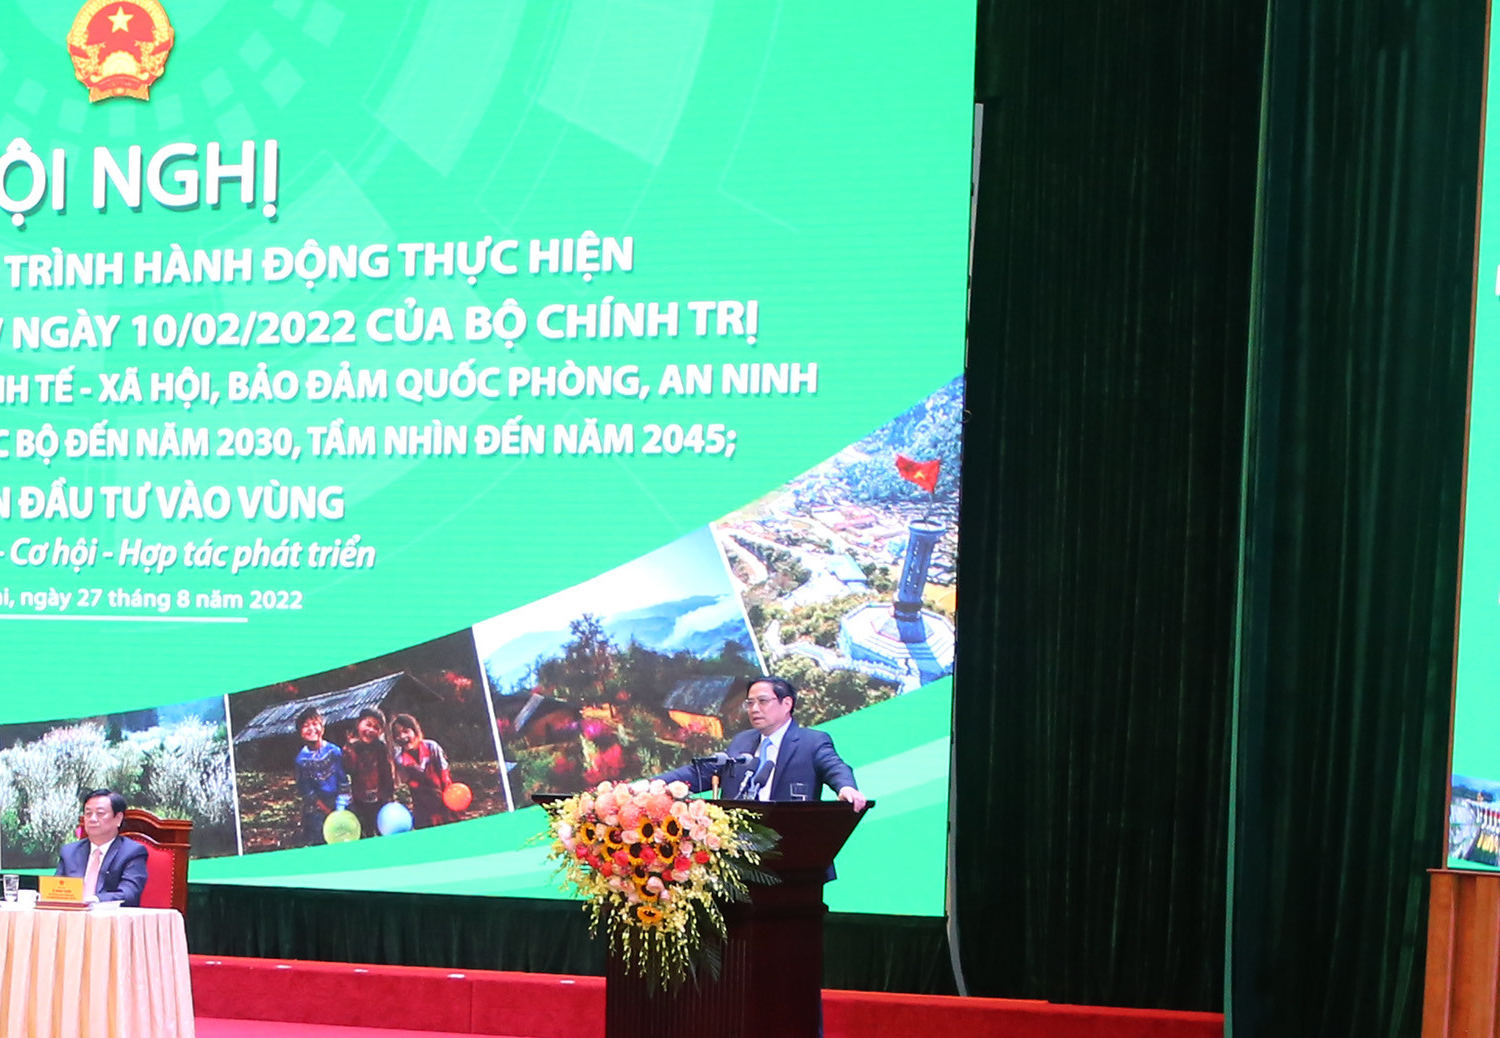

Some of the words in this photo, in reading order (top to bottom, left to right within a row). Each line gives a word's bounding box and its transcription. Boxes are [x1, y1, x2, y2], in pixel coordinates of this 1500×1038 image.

[92, 138, 278, 218] NGHỊ
[3, 246, 124, 288] TRÌNH
[133, 242, 253, 284] HÀNH
[260, 238, 390, 290] ĐỘNG
[396, 235, 519, 285] THỰC
[528, 229, 634, 282] HIỆN
[12, 308, 121, 350] NGÀY
[131, 309, 357, 348] 10/02/2022
[365, 296, 455, 342] CỦA
[464, 297, 527, 350] BỘ
[536, 295, 679, 339] CHÍNH
[687, 299, 759, 345] TRỊ
[34, 364, 75, 403] TẾ
[97, 366, 143, 403] XÃ
[150, 365, 221, 410] HỘI,
[228, 361, 300, 401] BẢO
[304, 360, 388, 400] ĐẢM
[395, 357, 501, 402] QUỐC
[508, 359, 651, 400] PHÒNG,
[657, 363, 713, 395] AN
[721, 361, 818, 395] NINH
[15, 422, 60, 466] BỘ
[63, 419, 129, 458] ĐẾN
[135, 421, 210, 457] NĂM
[215, 426, 302, 461] 2030,
[306, 417, 377, 456] TẦM
[383, 418, 468, 456] NHÌN
[473, 414, 546, 455] ĐẾN
[553, 417, 634, 455] NĂM
[641, 423, 736, 454] 2045;
[17, 476, 94, 519] ĐẦU
[99, 480, 152, 520] TƯ
[154, 479, 232, 520] VÀO
[236, 478, 345, 520] VÙNG
[9, 537, 50, 566] Cơ
[51, 536, 99, 573] hội
[118, 537, 178, 574] Hợp
[183, 537, 229, 567] tác
[231, 537, 304, 574] phát
[307, 533, 376, 568] triển
[20, 587, 73, 612] ngày
[76, 588, 103, 607] 27
[107, 587, 172, 613] tháng
[176, 589, 191, 609] 8
[195, 589, 244, 609] năm
[249, 589, 304, 610] 2022
